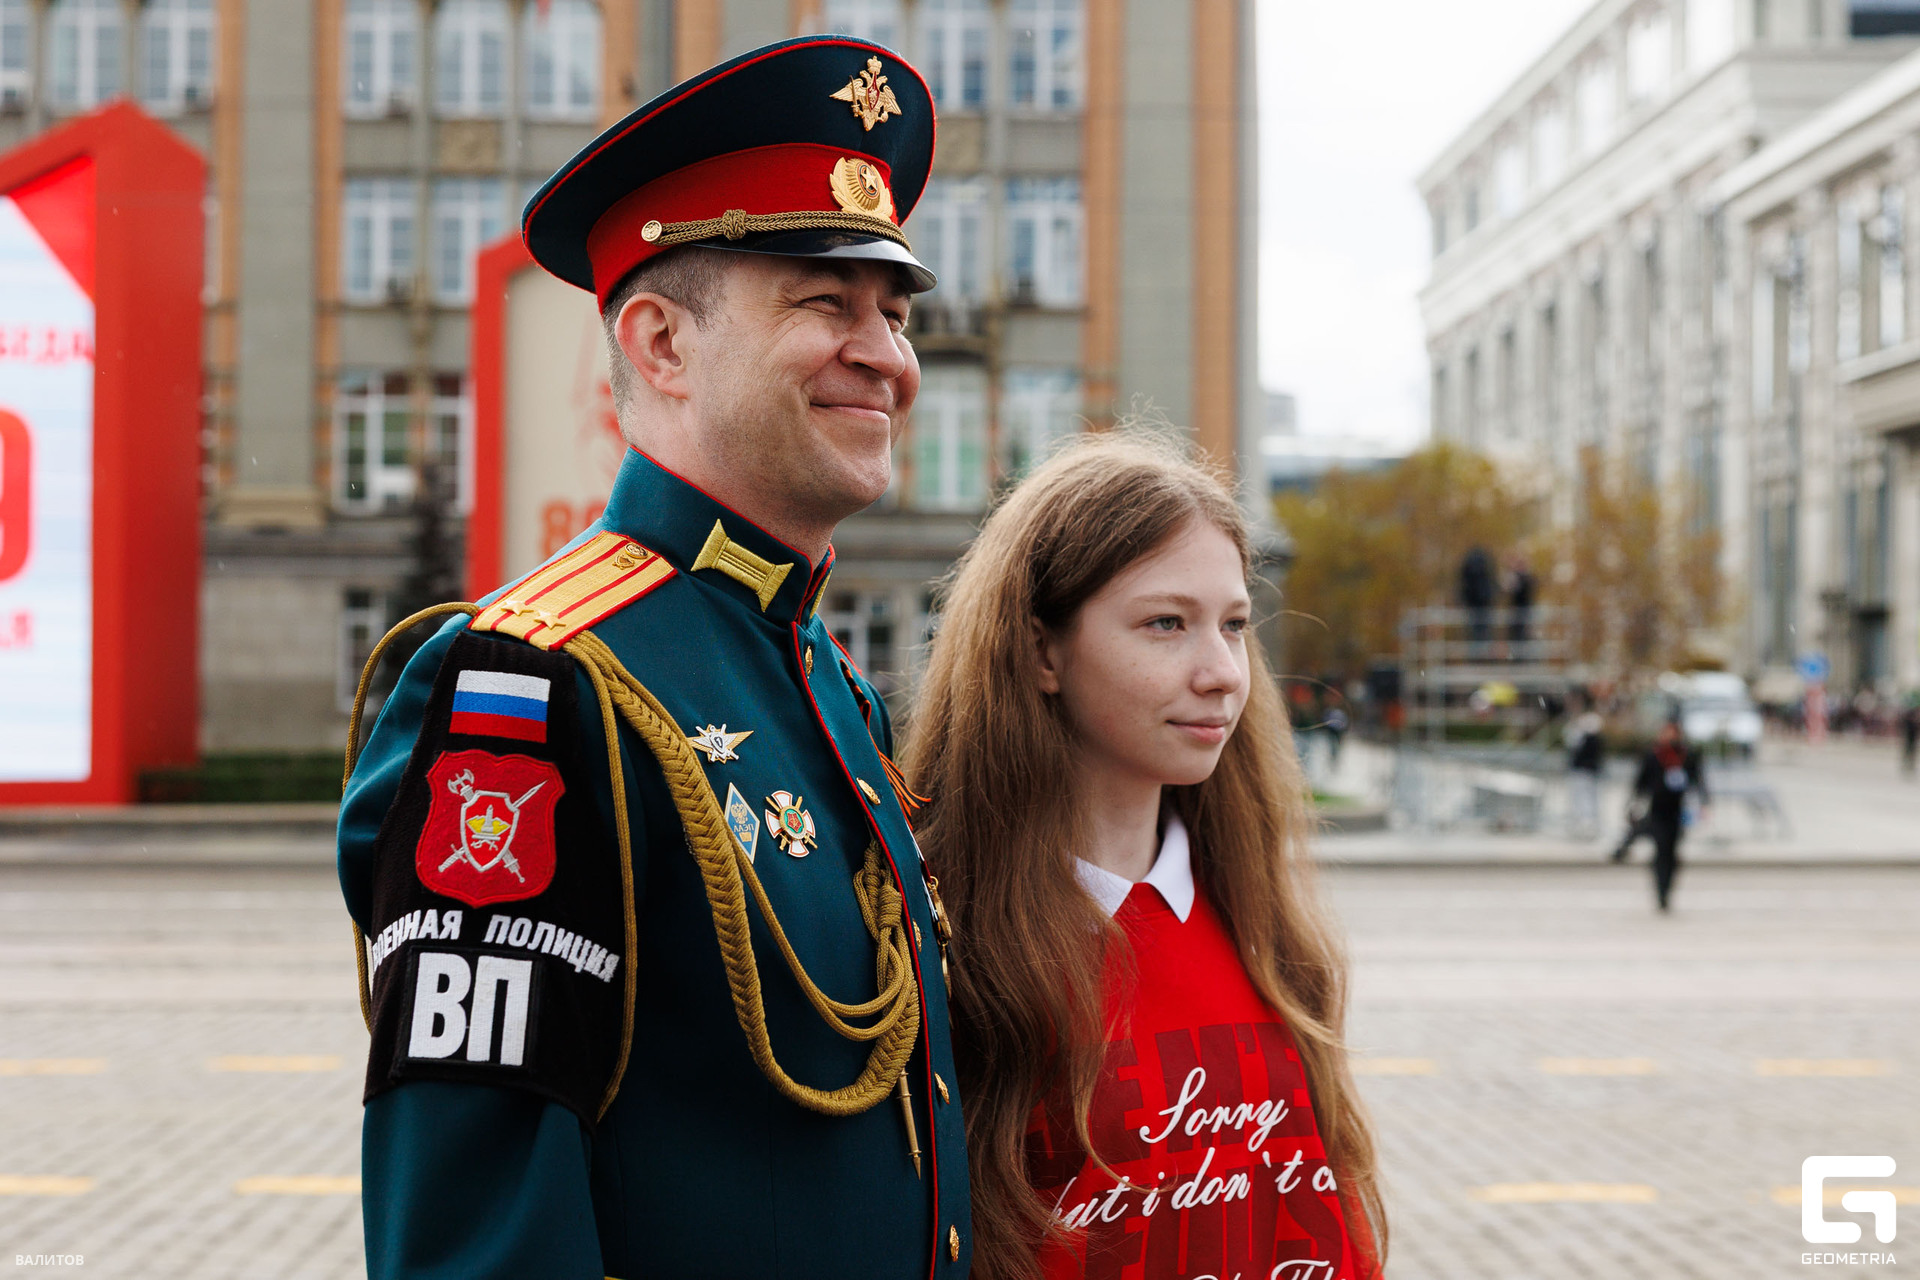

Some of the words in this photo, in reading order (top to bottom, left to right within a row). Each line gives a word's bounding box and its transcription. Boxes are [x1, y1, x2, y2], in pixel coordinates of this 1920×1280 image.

[372, 909, 463, 972] ВОЕННАЯ
[481, 914, 620, 983] ПОЛИЦИЯ
[408, 952, 533, 1067] ВП
[1138, 1066, 1290, 1152] Sorry
[1142, 1171, 1161, 1217] i
